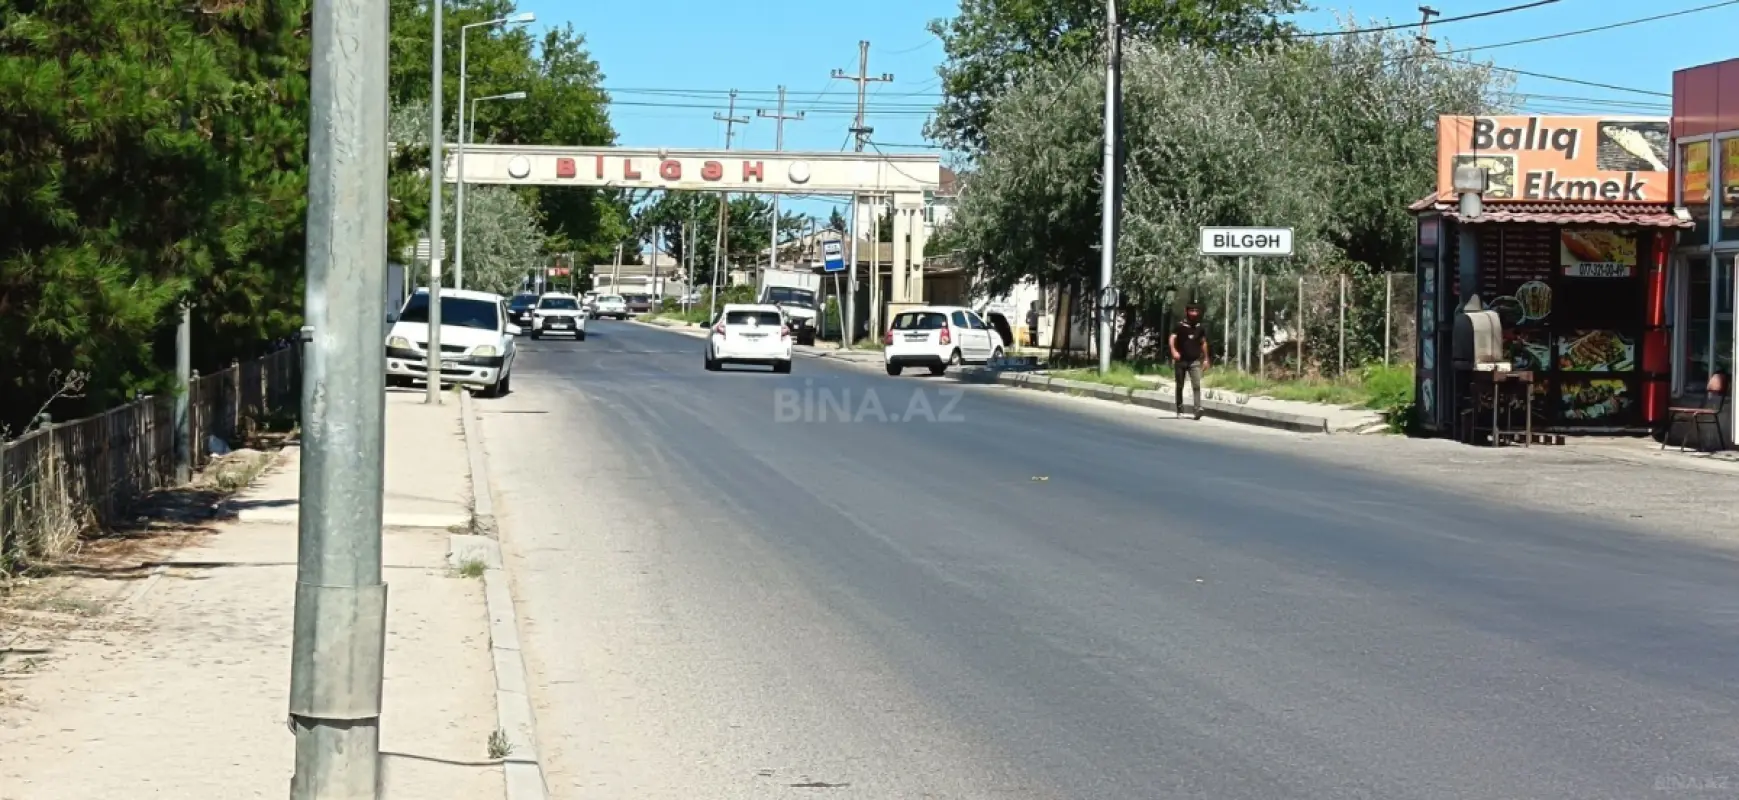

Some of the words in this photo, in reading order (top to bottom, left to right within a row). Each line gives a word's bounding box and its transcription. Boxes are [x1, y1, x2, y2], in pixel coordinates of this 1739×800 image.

[1470, 117, 1581, 160] Balıq
[1523, 169, 1648, 200] Ekmek
[1213, 232, 1280, 249] BİLGƏH
